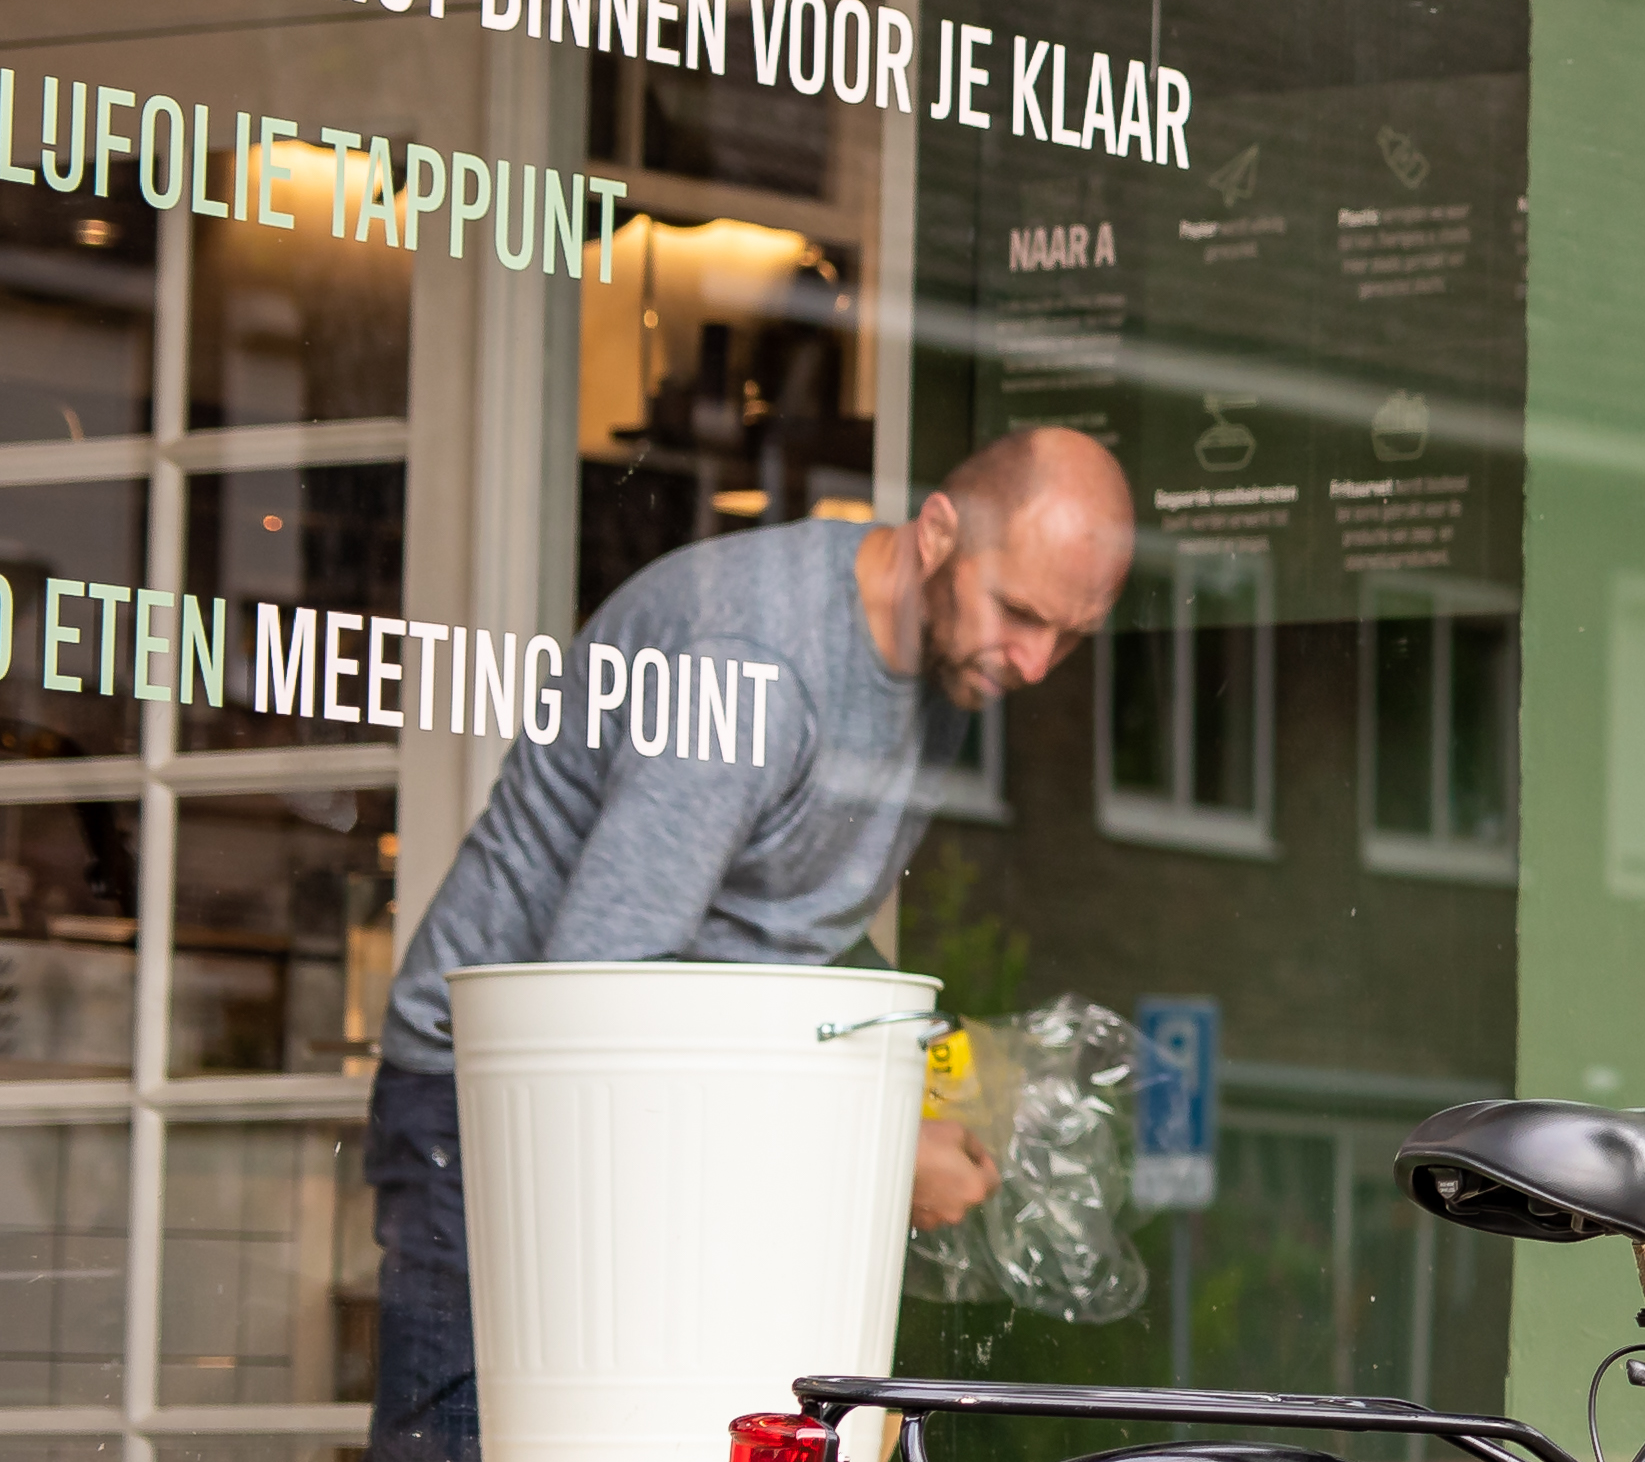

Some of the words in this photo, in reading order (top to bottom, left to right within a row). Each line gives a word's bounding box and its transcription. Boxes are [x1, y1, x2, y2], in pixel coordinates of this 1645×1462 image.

[930, 20, 992, 129] JE
[1011, 38, 1193, 170] KLAAR
[321, 127, 628, 285] TAPPUNT
[43, 576, 227, 708] ETEN
[254, 601, 563, 746] MEETING
[586, 642, 779, 769] POINT
